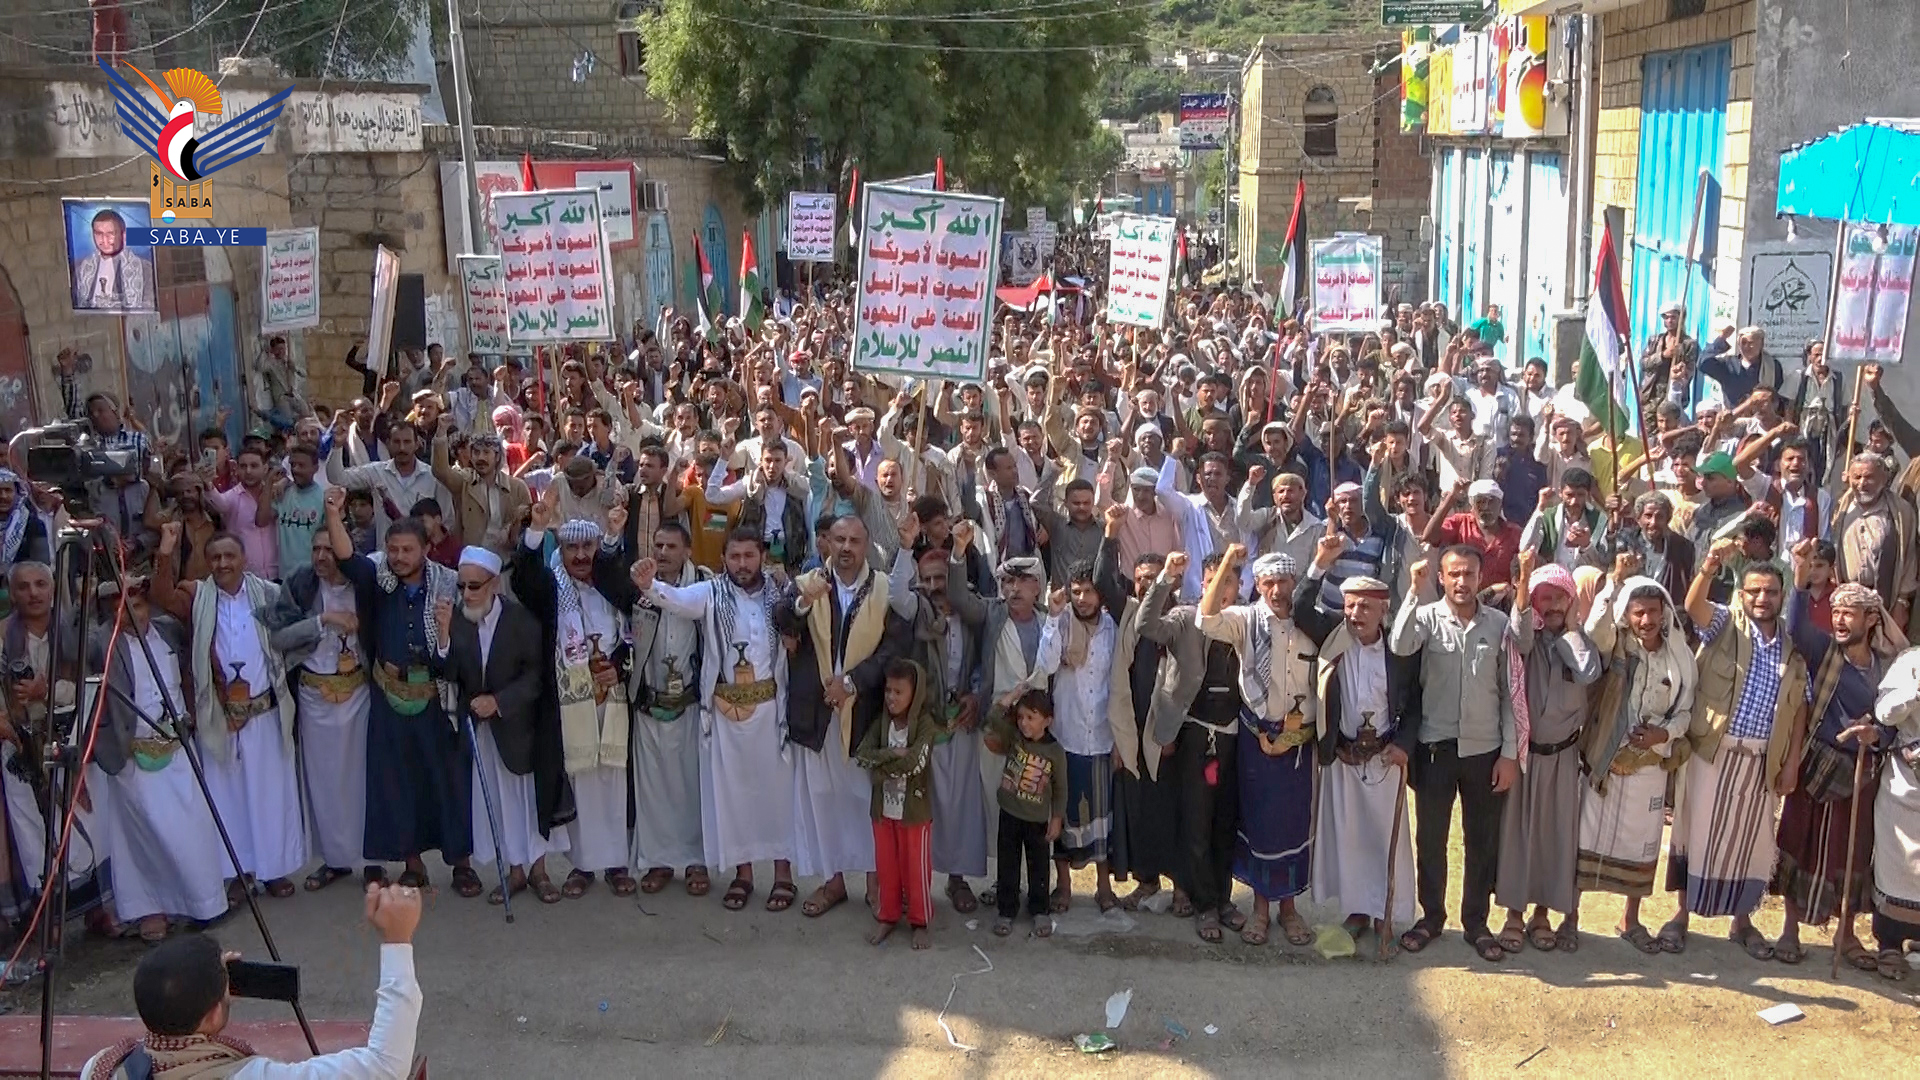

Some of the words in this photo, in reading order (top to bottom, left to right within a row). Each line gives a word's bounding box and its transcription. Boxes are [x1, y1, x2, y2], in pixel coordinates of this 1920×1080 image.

[501, 197, 556, 234] أكبر
[560, 199, 595, 224] الله
[869, 198, 945, 238] أكبر
[946, 205, 991, 237] الله
[502, 231, 553, 256] لأمريكا
[556, 232, 598, 254] الموت
[869, 238, 931, 266] لأمريكا
[558, 259, 600, 280] الموت
[936, 248, 987, 270] الموت
[505, 261, 555, 282] لإسرائيل
[508, 286, 543, 306] اليهود
[547, 285, 566, 304] على
[571, 284, 602, 300] اللعنة
[865, 271, 929, 300] لإسرائيل
[932, 280, 985, 302] الموت
[510, 307, 558, 336] للإسلام
[563, 305, 605, 334] النصر
[862, 304, 906, 327] اليهود
[911, 309, 936, 330] على
[941, 309, 982, 332] اللعنة
[859, 329, 921, 367] للإسلام
[923, 336, 979, 367] النصر
